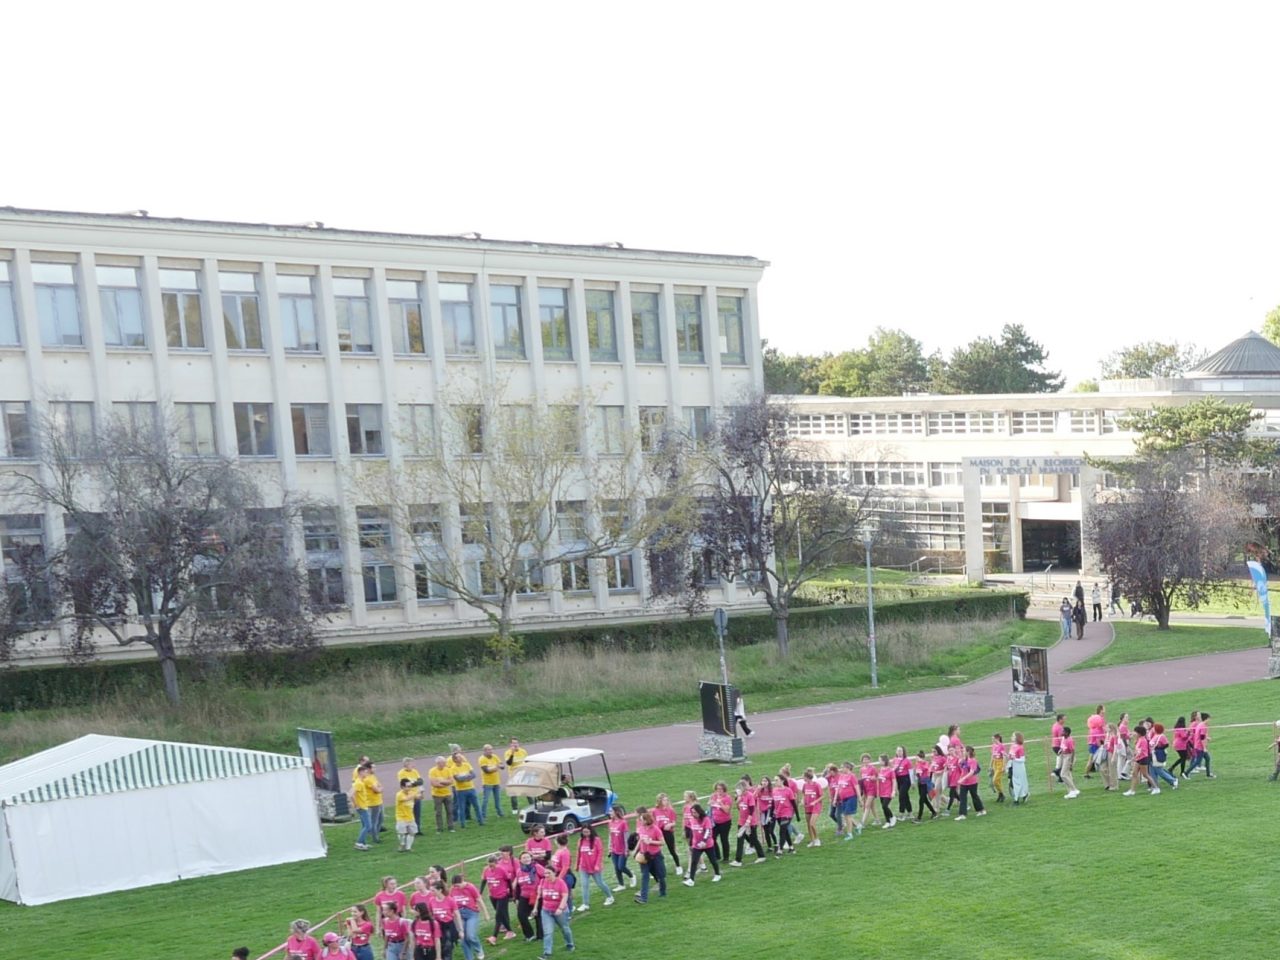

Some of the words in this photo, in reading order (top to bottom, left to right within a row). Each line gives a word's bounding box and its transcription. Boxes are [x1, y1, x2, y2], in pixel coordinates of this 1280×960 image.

[970, 459, 1003, 467] MAISON
[1009, 459, 1020, 467] DE
[1027, 459, 1037, 467] LA
[980, 467, 990, 475] EN
[997, 467, 1032, 475] SCIENCES
[1040, 466, 1080, 475] HUMAINES
